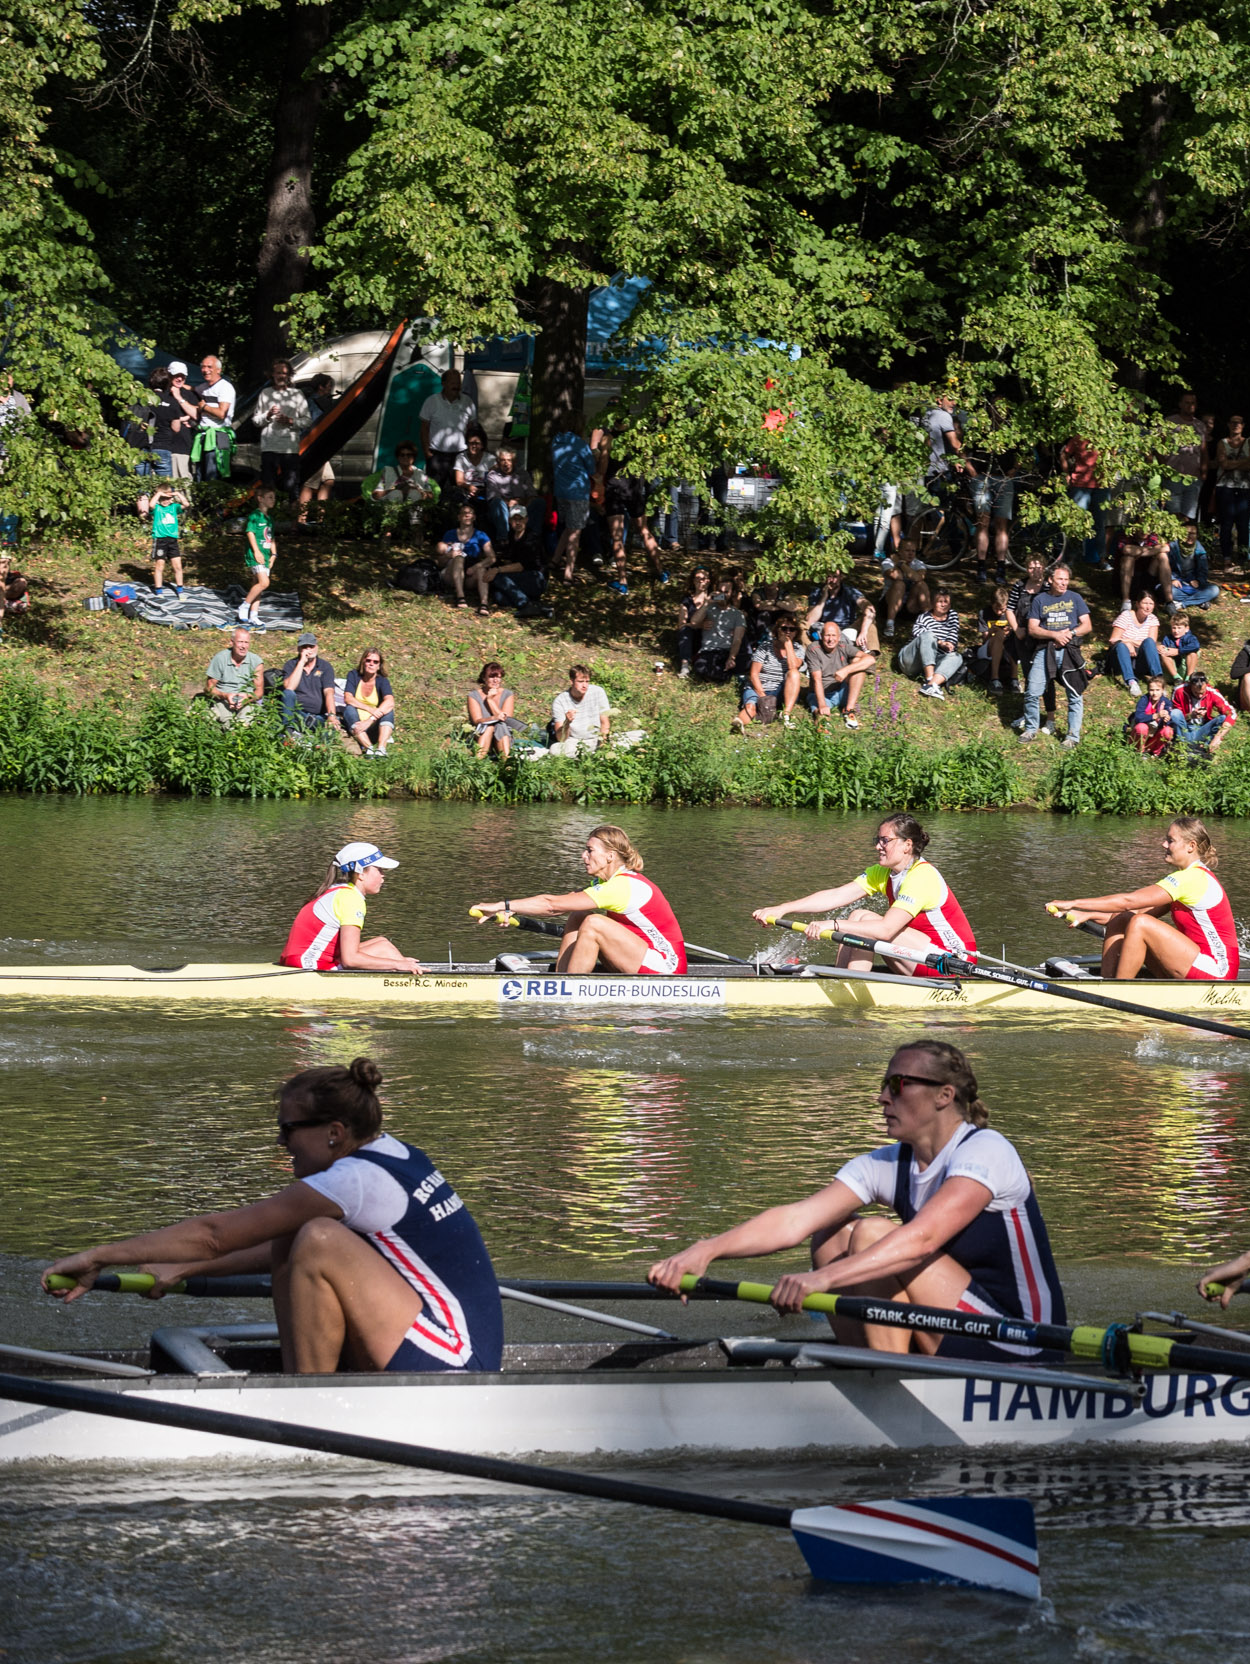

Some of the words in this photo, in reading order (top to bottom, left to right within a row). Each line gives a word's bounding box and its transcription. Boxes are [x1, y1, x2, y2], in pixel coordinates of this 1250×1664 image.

[435, 980, 468, 988] Minden
[526, 981, 572, 996] RBL
[579, 984, 721, 998] RUDER-BUNDESLIGA
[1199, 984, 1241, 1006] Melitta
[866, 1307, 906, 1324] STARK.
[908, 1313, 963, 1332] SCHNELL.
[964, 1321, 991, 1335] GUT.
[1006, 1327, 1029, 1340] RBL
